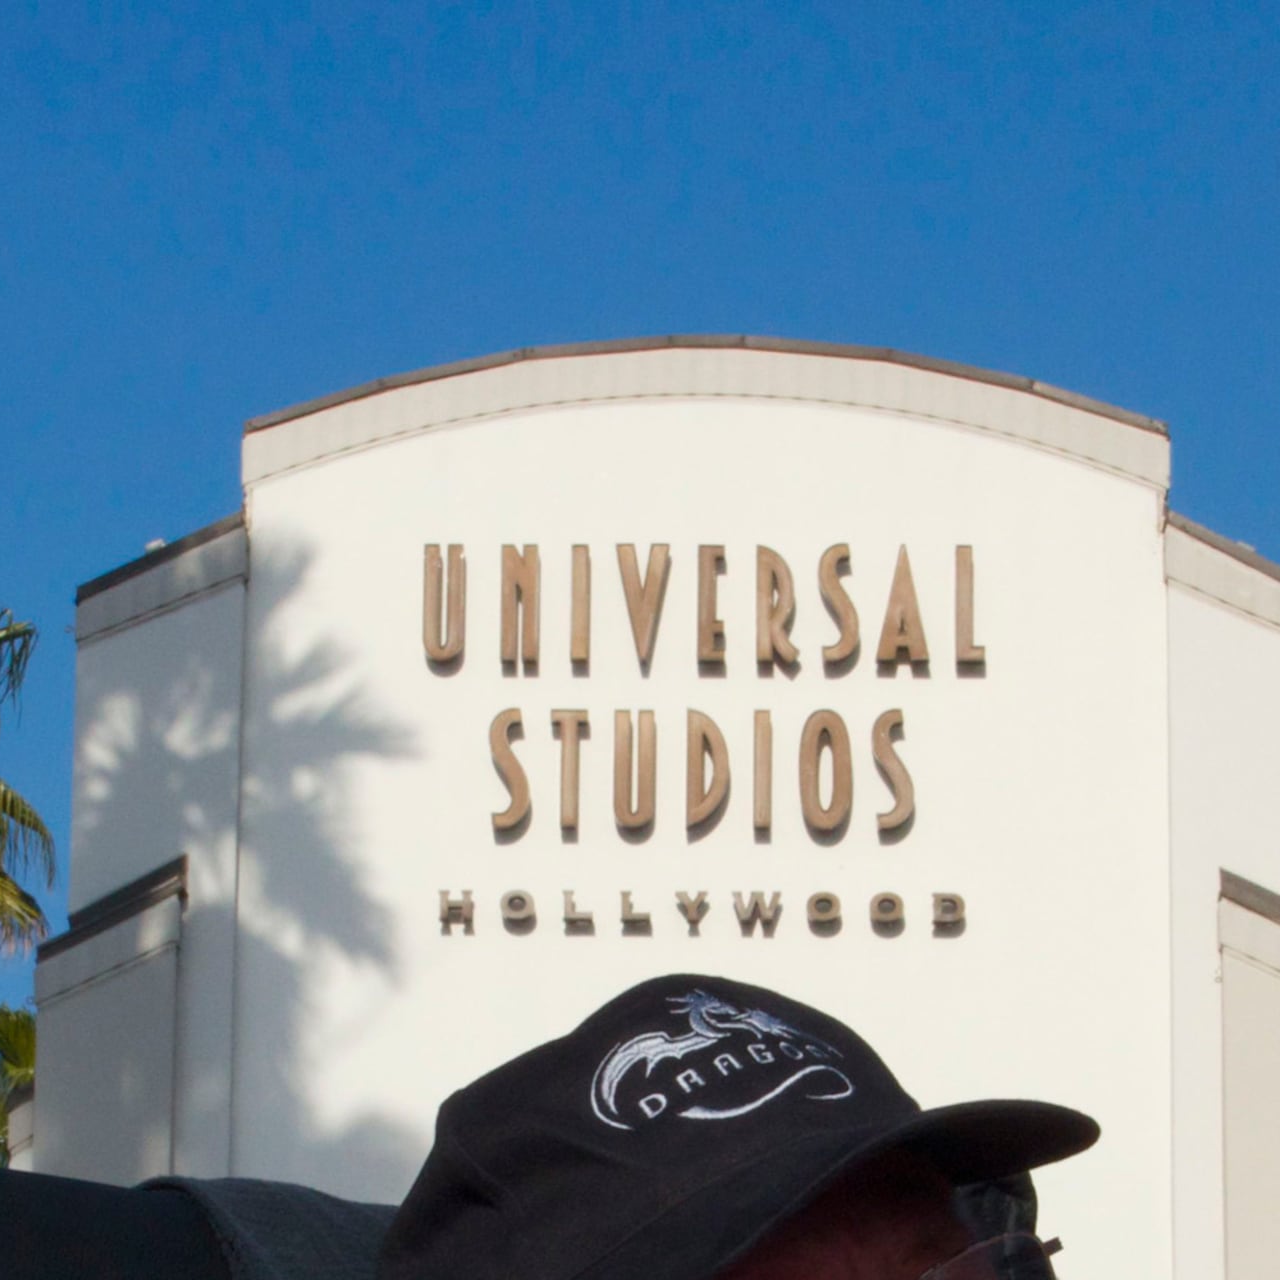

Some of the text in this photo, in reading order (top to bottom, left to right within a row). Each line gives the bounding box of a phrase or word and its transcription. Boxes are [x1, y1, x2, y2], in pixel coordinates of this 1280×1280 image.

[422, 542, 987, 679] UNIVERSAL
[488, 707, 916, 846] STUDIOS
[438, 889, 967, 938] HOLLYWOOD
